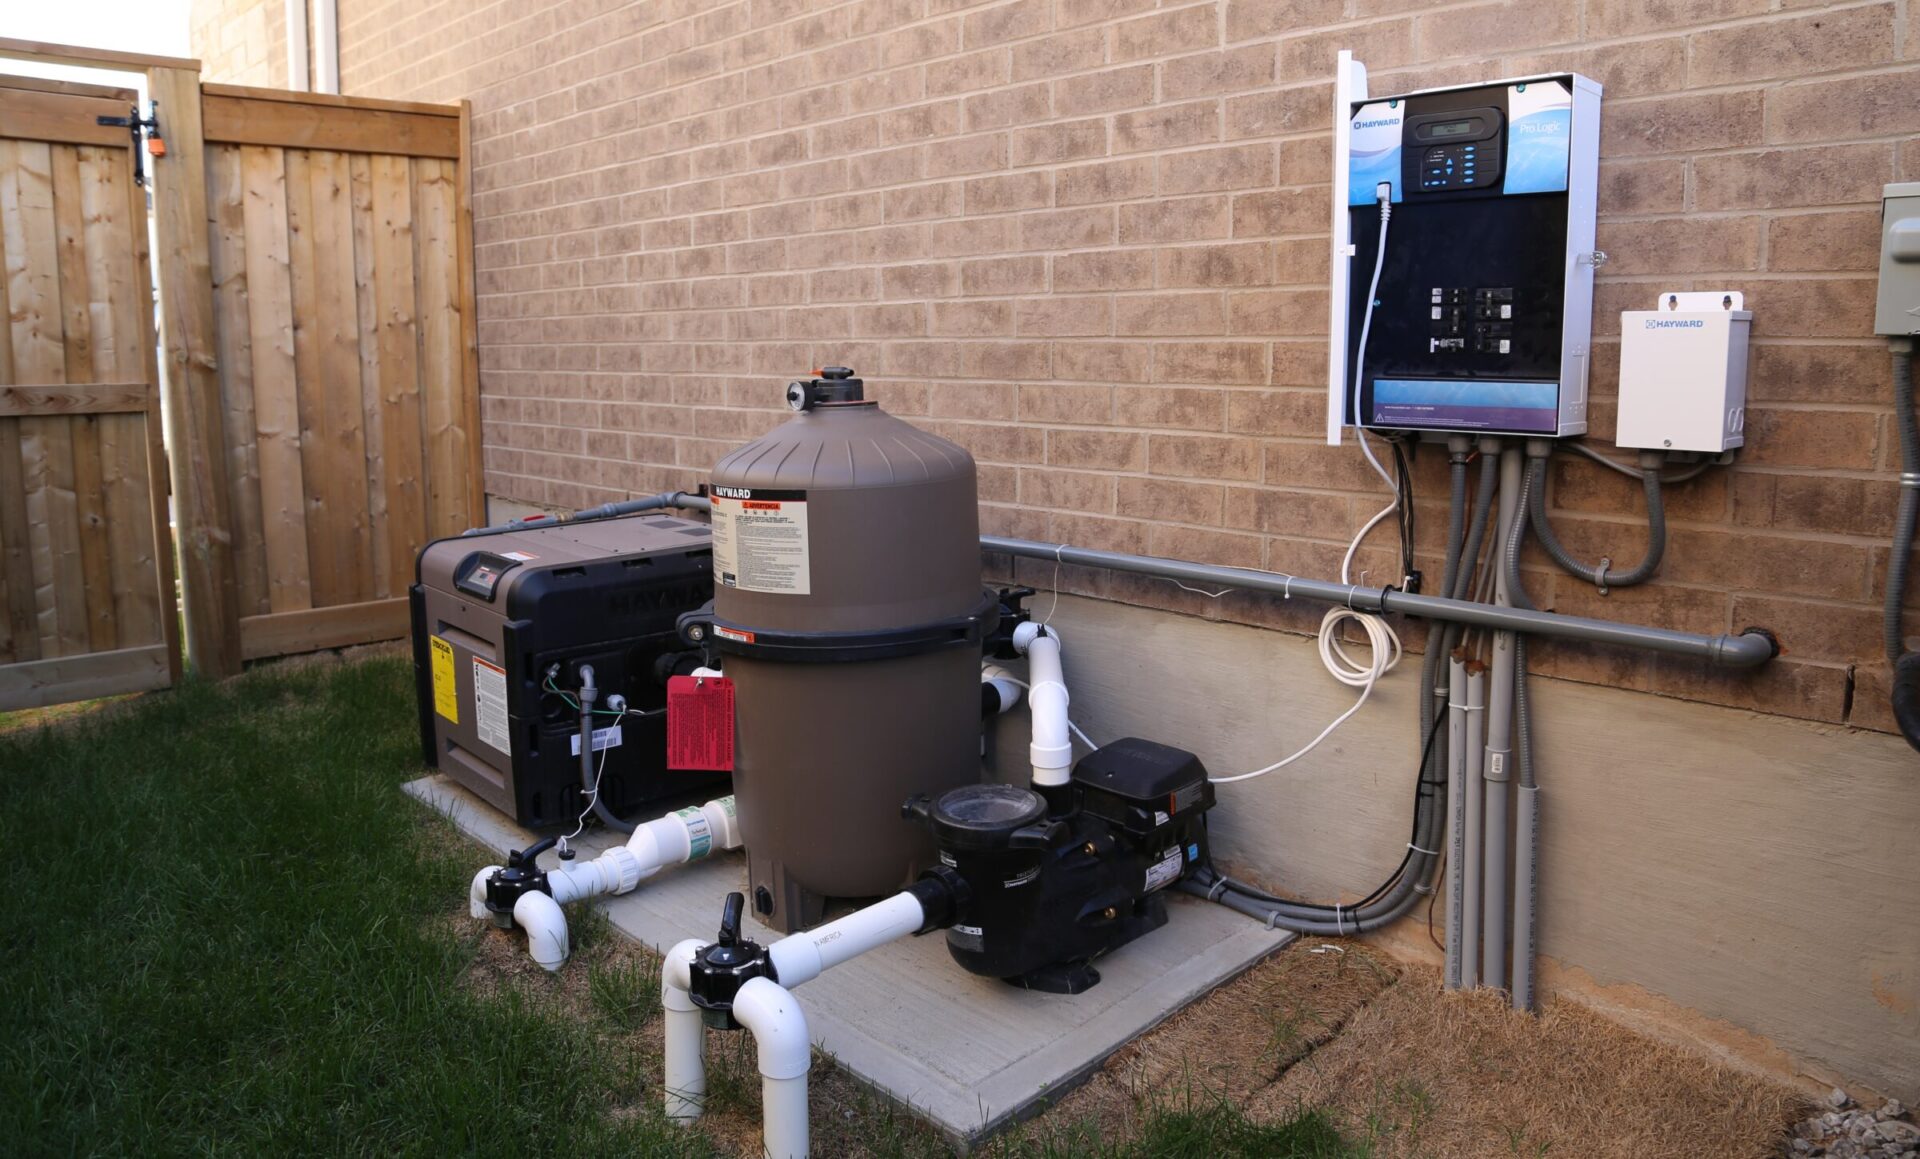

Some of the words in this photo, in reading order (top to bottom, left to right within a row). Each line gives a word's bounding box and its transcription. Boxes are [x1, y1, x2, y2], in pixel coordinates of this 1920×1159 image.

[1362, 117, 1400, 129] HAYWARD
[1519, 123, 1536, 135] Pro
[1536, 120, 1561, 134] Logic
[1656, 320, 1704, 328] HAYWARD
[715, 486, 751, 499] HAYWARD
[818, 930, 843, 946] AMERICA
